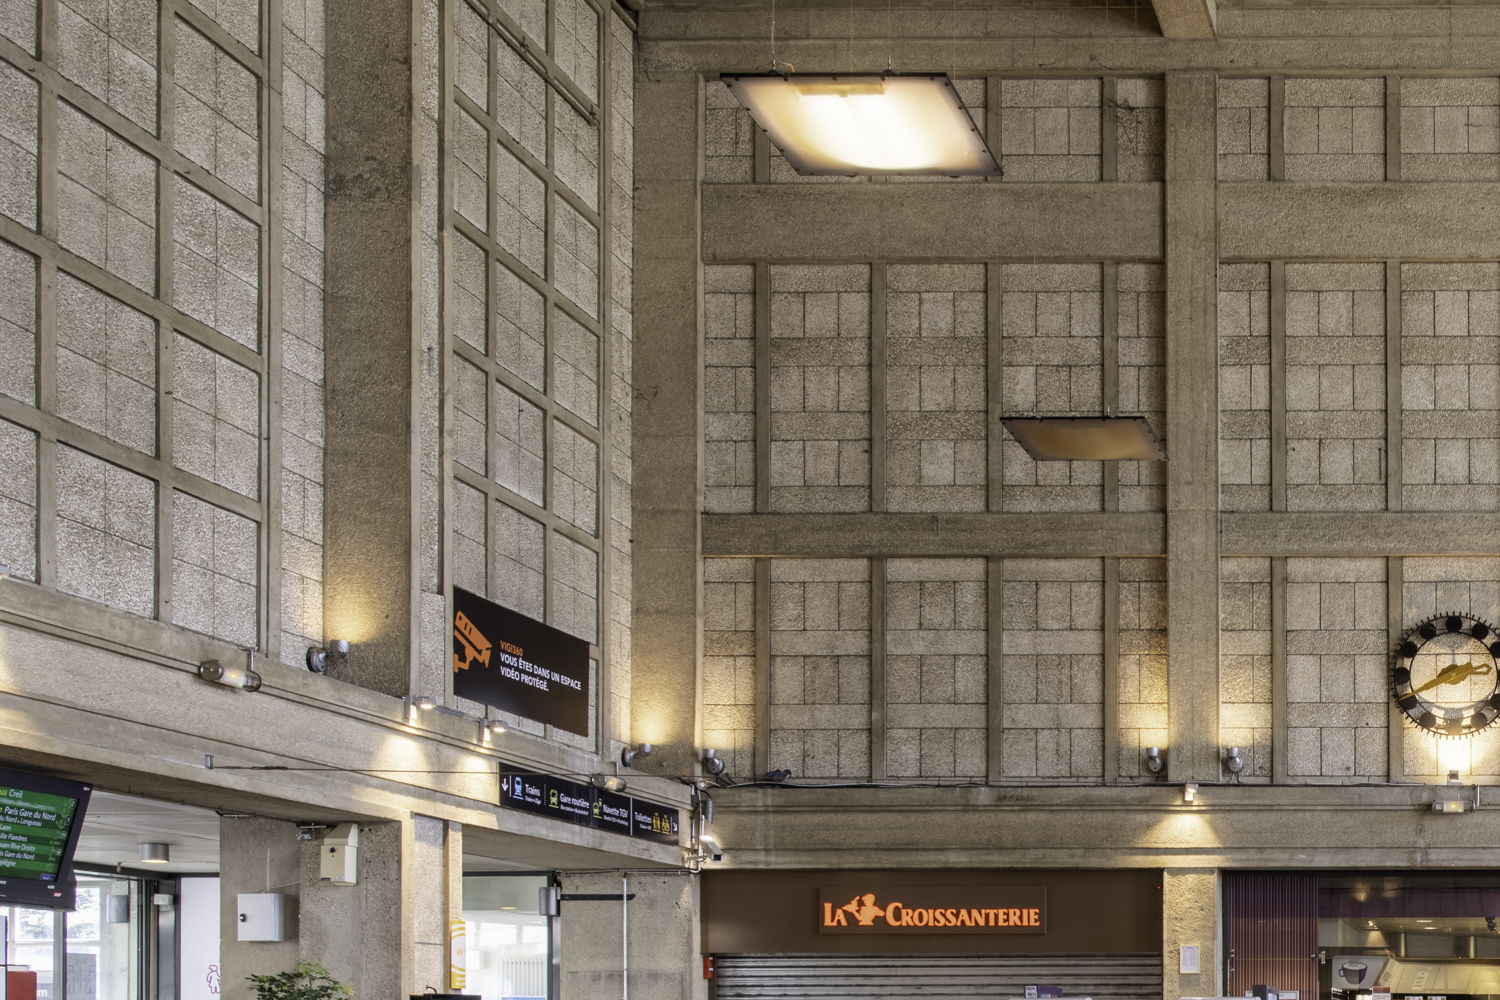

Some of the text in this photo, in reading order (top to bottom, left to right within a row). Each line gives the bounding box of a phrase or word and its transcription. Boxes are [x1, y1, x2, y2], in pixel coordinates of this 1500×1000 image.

[500, 640, 523, 657] VIGI360
[500, 652, 582, 691] VOUS ÊTES DANS UN ESPACE
[500, 665, 549, 692] VIDÉO PROTÉGÉ.
[9, 789, 24, 798] Creil
[525, 783, 541, 797] Trains
[560, 792, 590, 809] Gare routière
[4, 806, 18, 816] Paris
[19, 808, 33, 817] Gare
[42, 812, 56, 821] Nord
